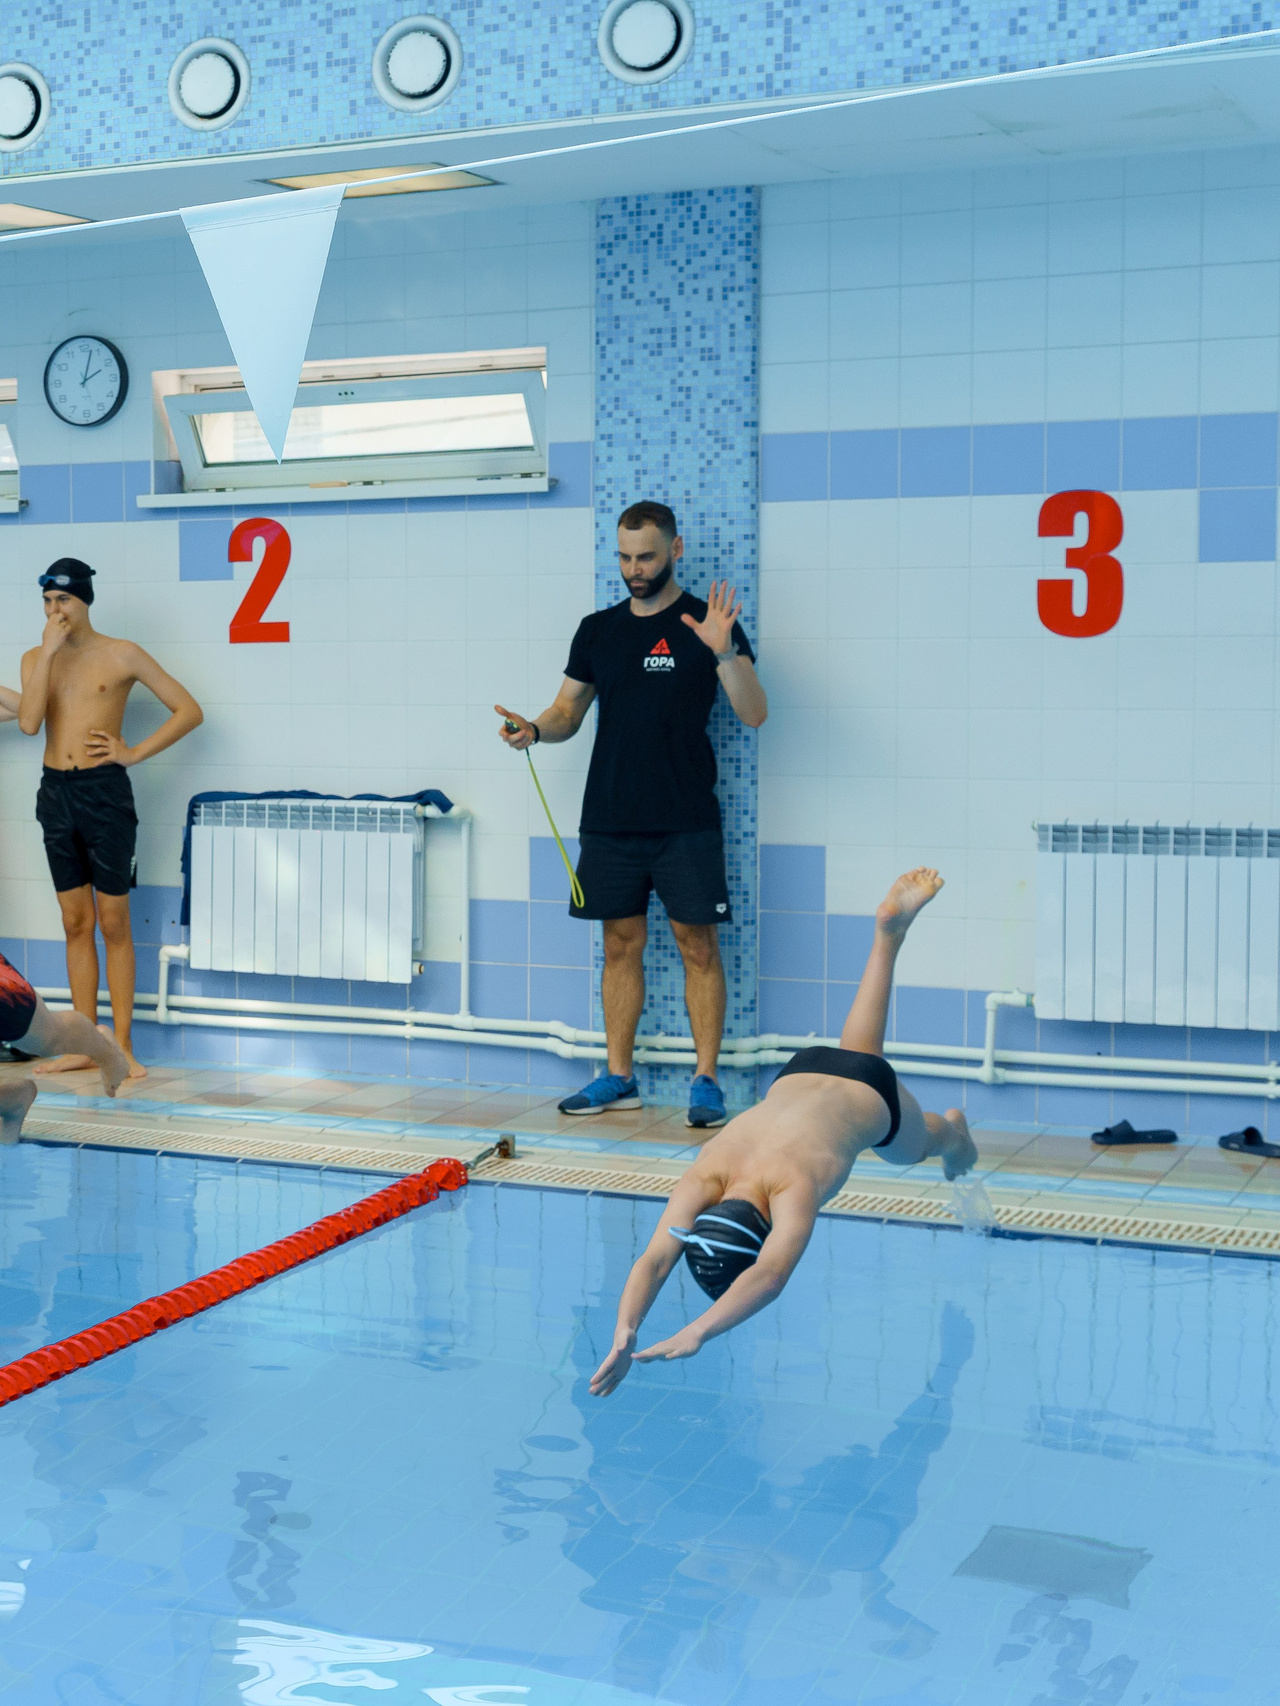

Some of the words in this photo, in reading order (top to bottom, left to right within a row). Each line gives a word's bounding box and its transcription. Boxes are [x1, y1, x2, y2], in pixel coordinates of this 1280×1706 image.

[78, 343, 91, 353] 12
[66, 350, 75, 359] 11
[58, 362, 69, 372] 10
[104, 358, 113, 367] 2
[109, 373, 118, 382] 3
[53, 379, 62, 388] 9
[59, 394, 67, 403] 8
[106, 390, 114, 398] 4
[69, 405, 77, 415] 7
[96, 401, 105, 412] 5
[82, 409, 91, 418] 6
[1037, 489, 1124, 638] 3
[228, 517, 291, 644] 2
[643, 656, 675, 668] ГОРА
